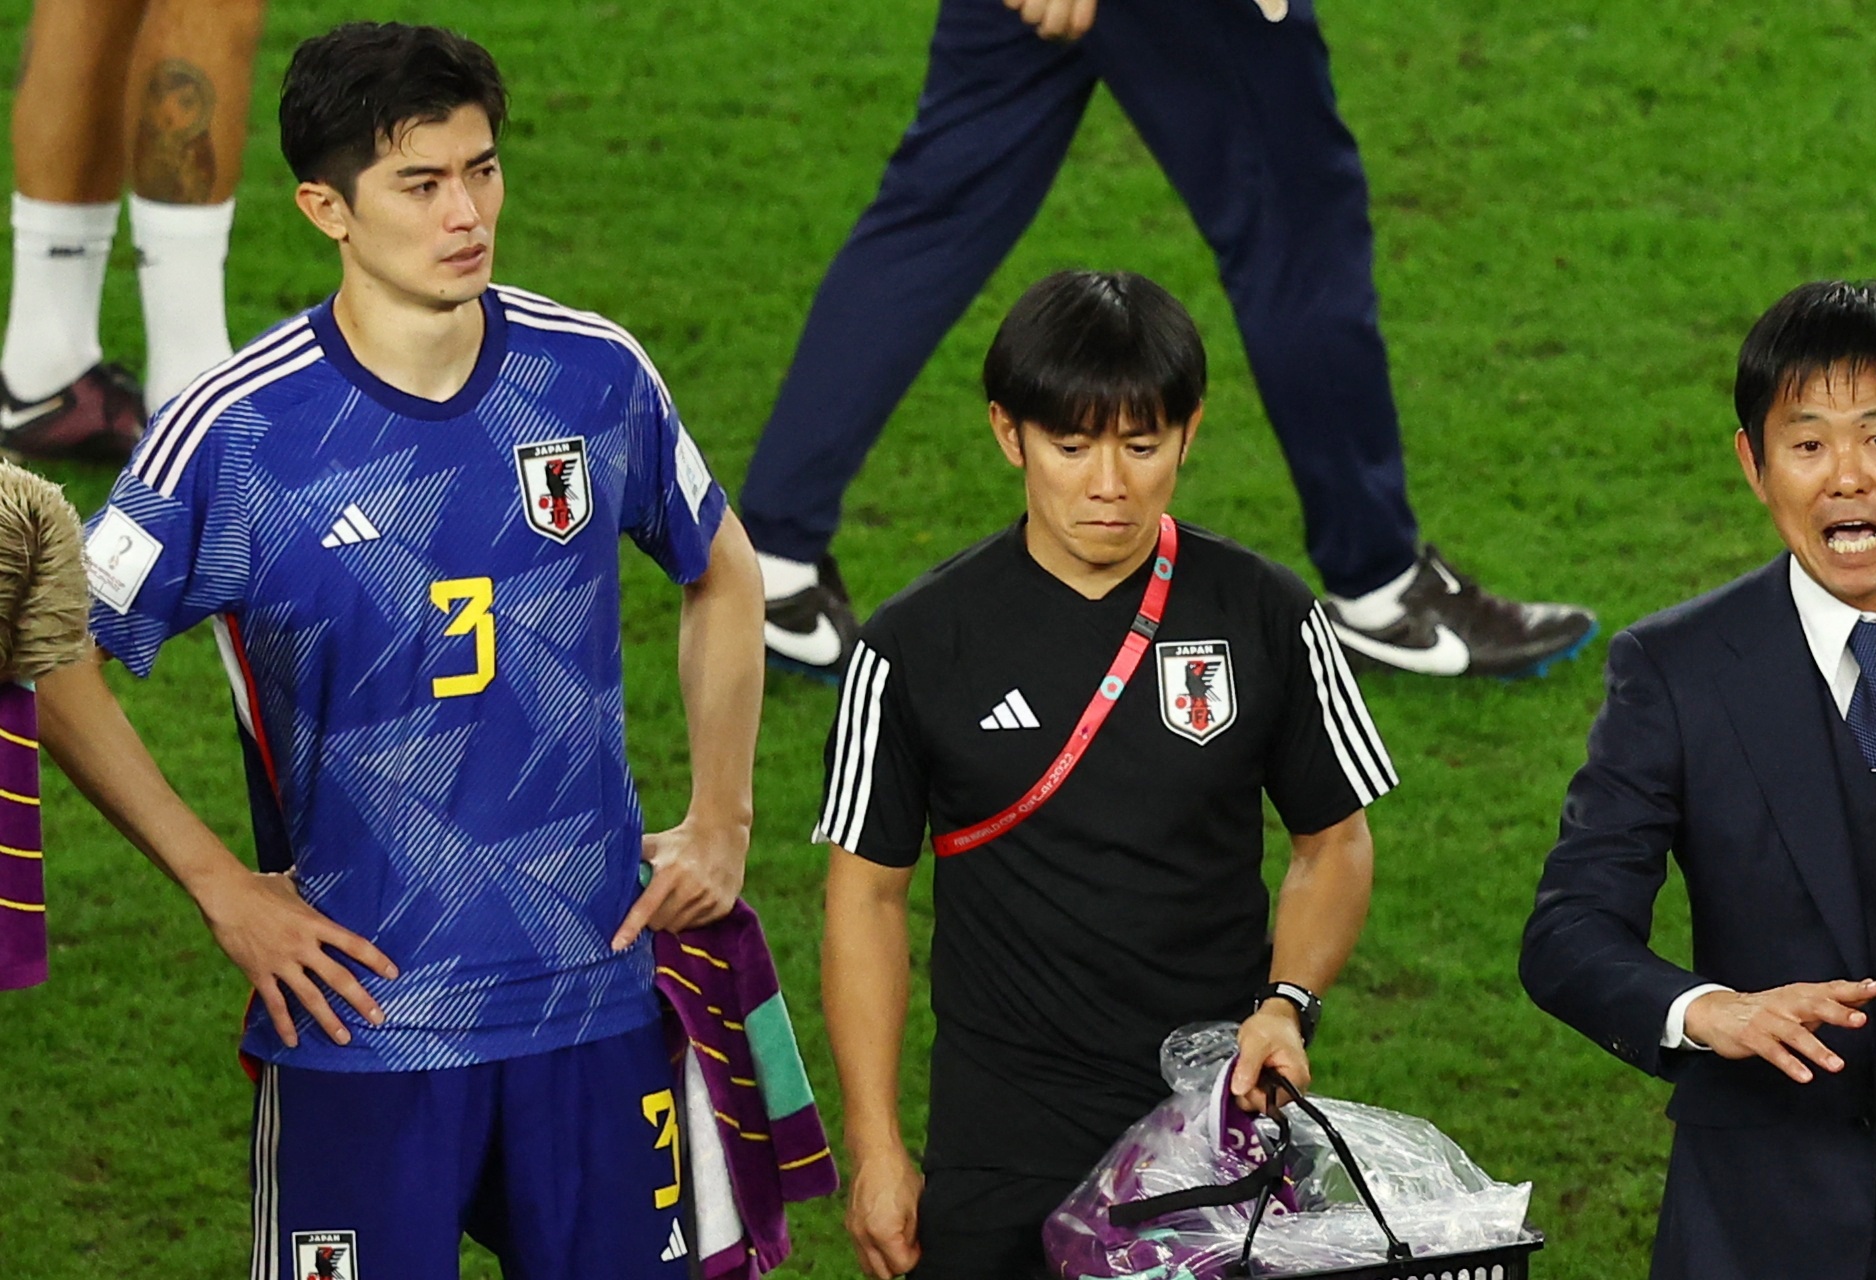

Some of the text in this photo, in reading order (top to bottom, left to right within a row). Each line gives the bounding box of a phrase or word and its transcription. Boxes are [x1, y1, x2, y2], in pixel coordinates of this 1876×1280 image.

[534, 443, 570, 456] JAPAN
[430, 576, 496, 698] 3
[1175, 645, 1213, 655] JAPAN
[1018, 753, 1074, 812] Qatar2022
[642, 1088, 680, 1209] 3
[308, 1234, 341, 1242] JAPAN
